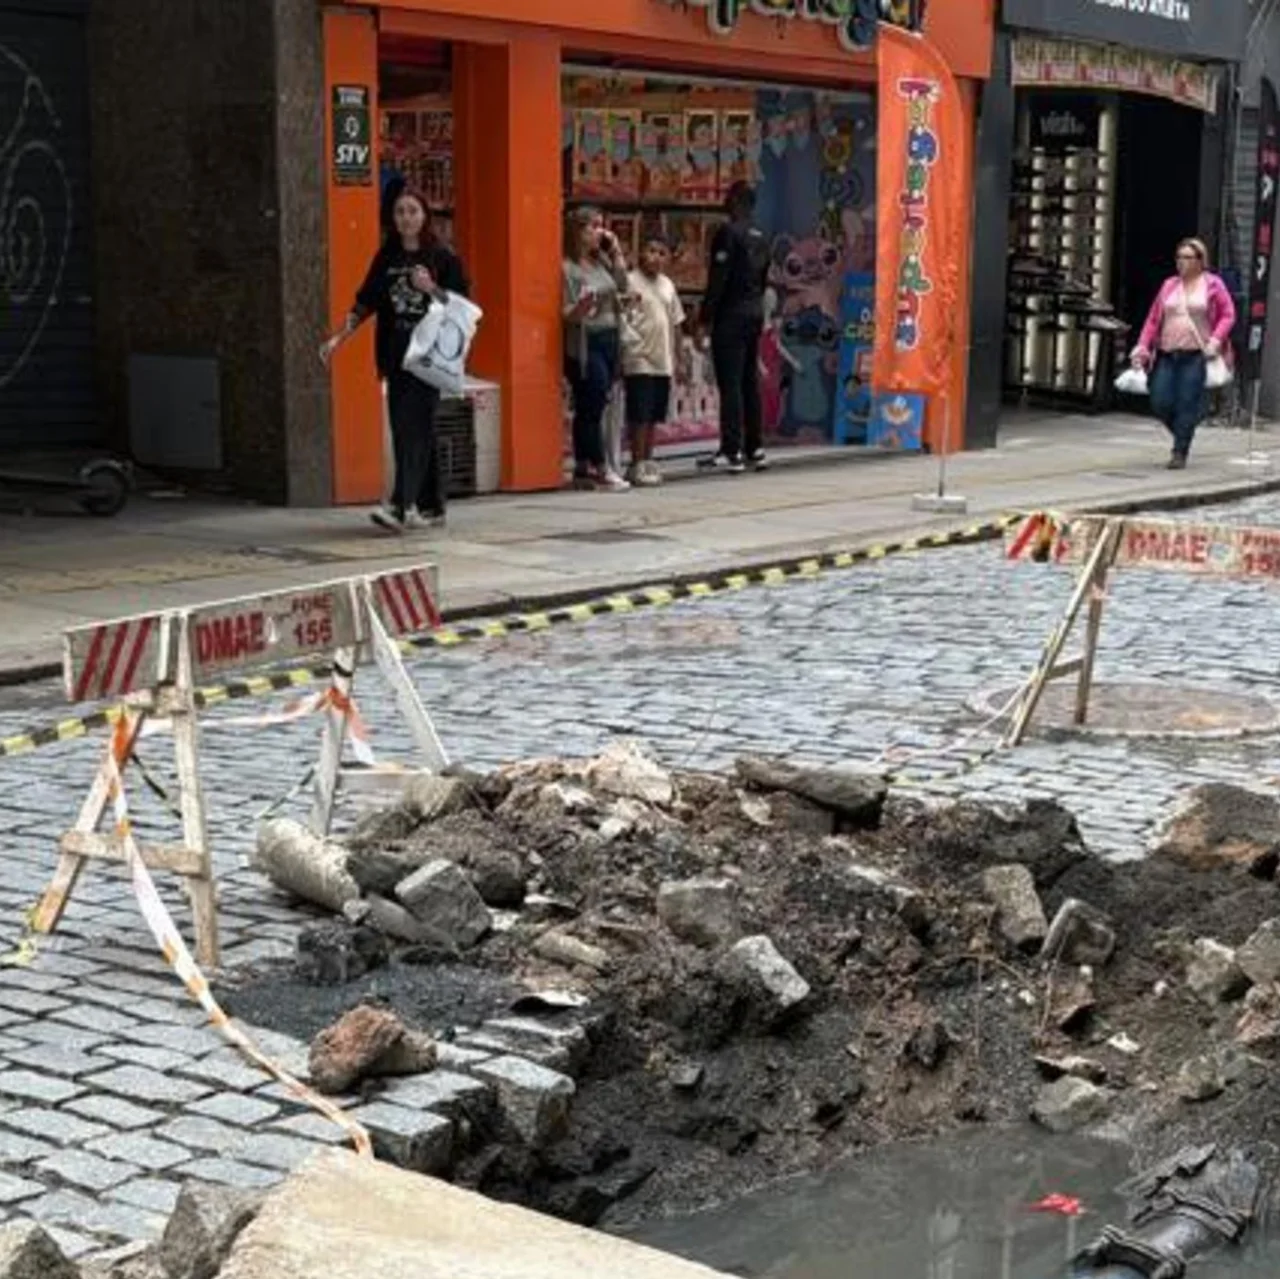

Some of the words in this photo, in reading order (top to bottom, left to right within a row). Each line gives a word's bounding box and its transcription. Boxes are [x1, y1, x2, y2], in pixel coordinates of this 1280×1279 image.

[335, 144, 369, 164] STV
[1127, 528, 1208, 563] DMAE
[195, 611, 265, 666] DMAE
